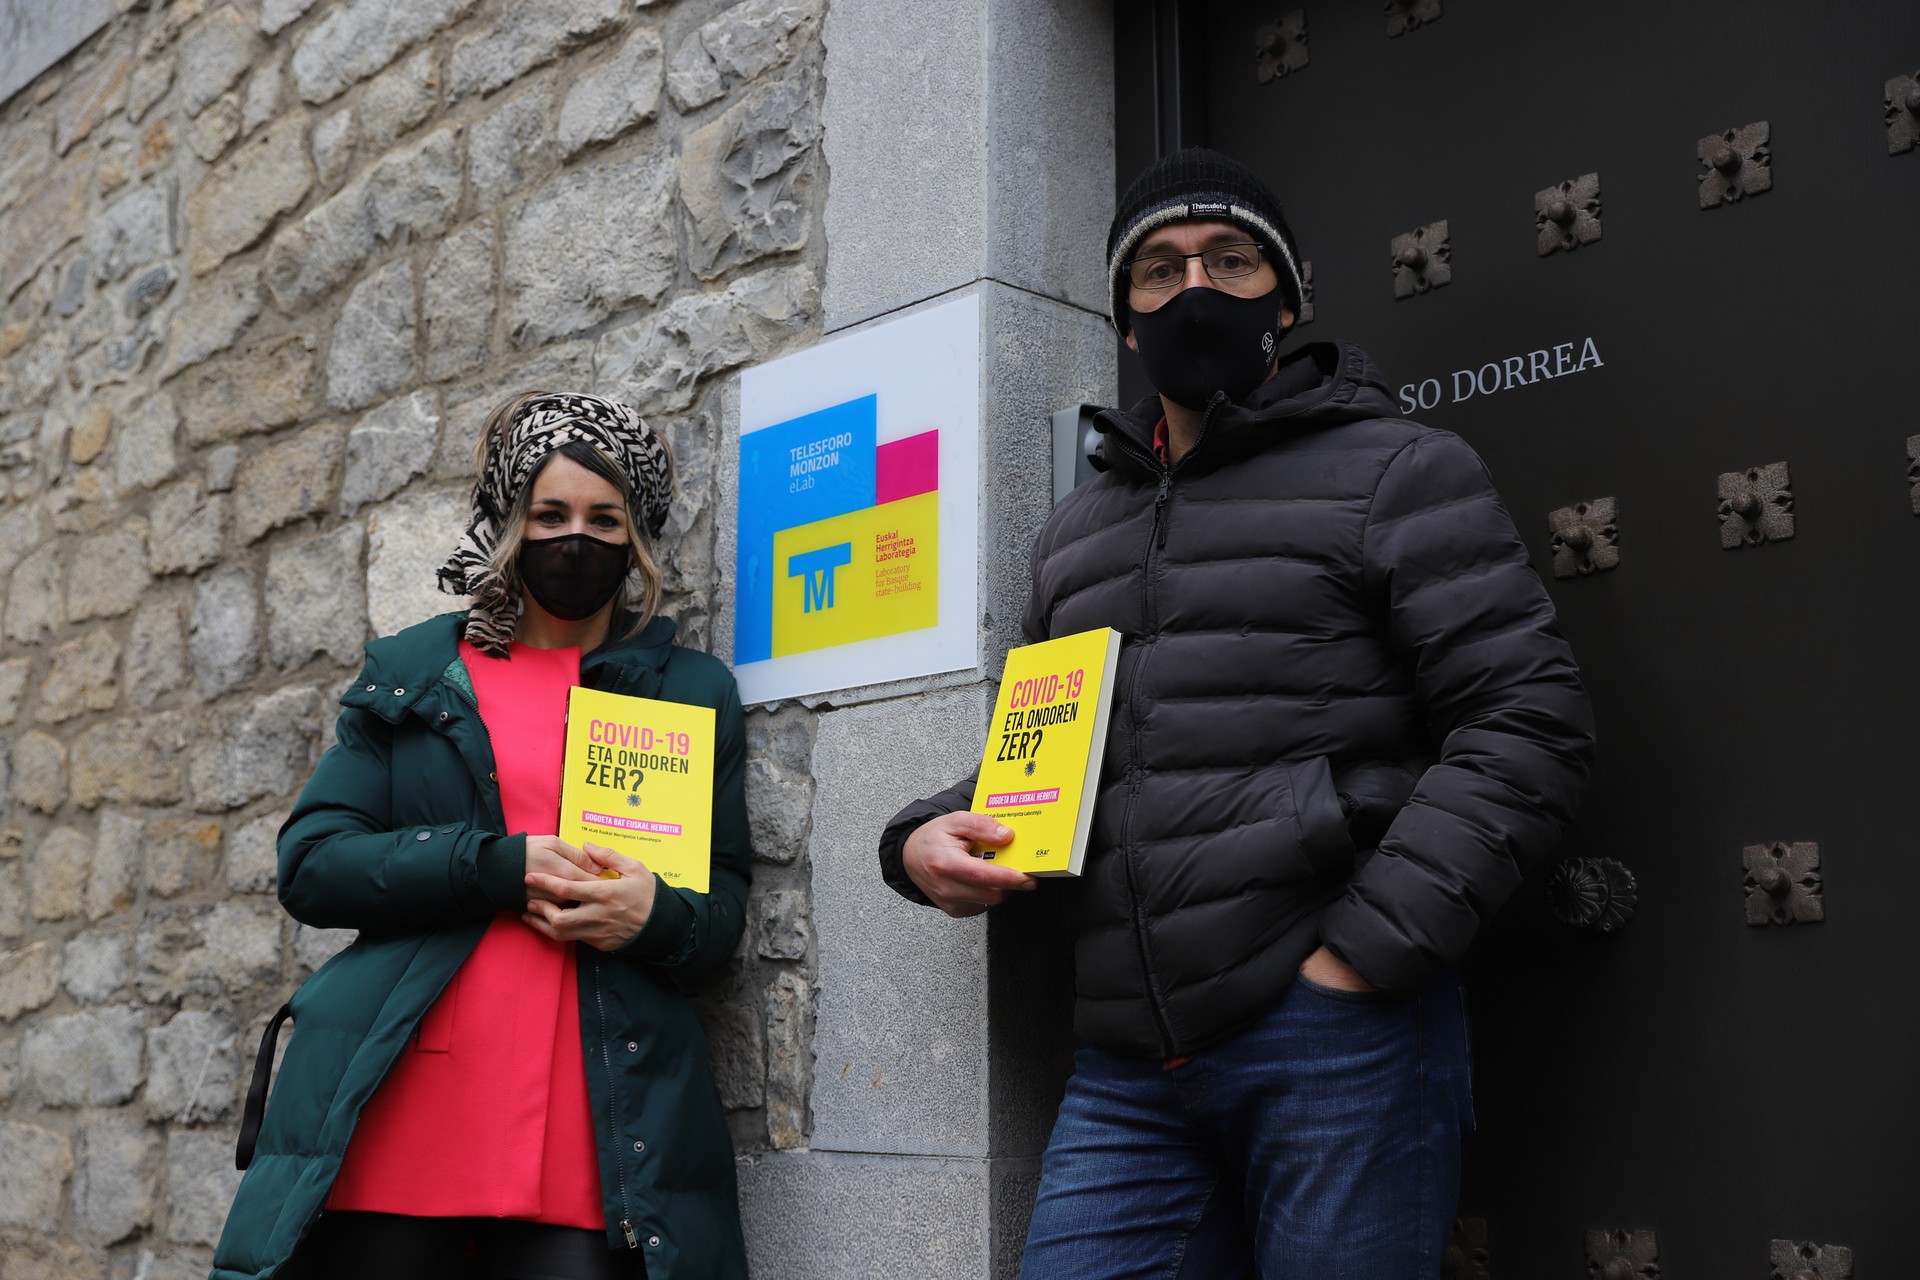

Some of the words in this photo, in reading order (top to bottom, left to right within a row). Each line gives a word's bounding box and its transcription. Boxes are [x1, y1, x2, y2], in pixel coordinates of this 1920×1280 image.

[1451, 336, 1604, 403] DORREA
[789, 431, 852, 462] TELESFORO
[789, 451, 839, 478] MONZON
[789, 474, 815, 493] eLab
[875, 529, 898, 543] Euskal
[875, 537, 914, 553] Herrigintza
[875, 546, 916, 563] Laborategia
[875, 564, 911, 578] Laboratory
[875, 579, 885, 588] for
[886, 574, 909, 586] Basque
[875, 581, 921, 598] state-building
[1010, 668, 1084, 709] COVID-19
[1004, 711, 1023, 732] ETA
[1026, 701, 1079, 730] ONDOREN
[589, 718, 690, 756] COVID-19
[997, 729, 1043, 762] ZER?
[588, 744, 613, 763] ETA
[618, 750, 689, 775] ONDOREN
[585, 762, 645, 792] ZER?
[988, 795, 1009, 806] GOGOETA
[1010, 794, 1019, 804] BAT
[1019, 793, 1036, 803] EUSKAL
[1036, 790, 1058, 801] HERRITIK
[585, 812, 612, 825] GOGOETA
[613, 818, 625, 827] BAT
[626, 820, 649, 830] EUSKAL
[650, 823, 680, 834] HERRITIK
